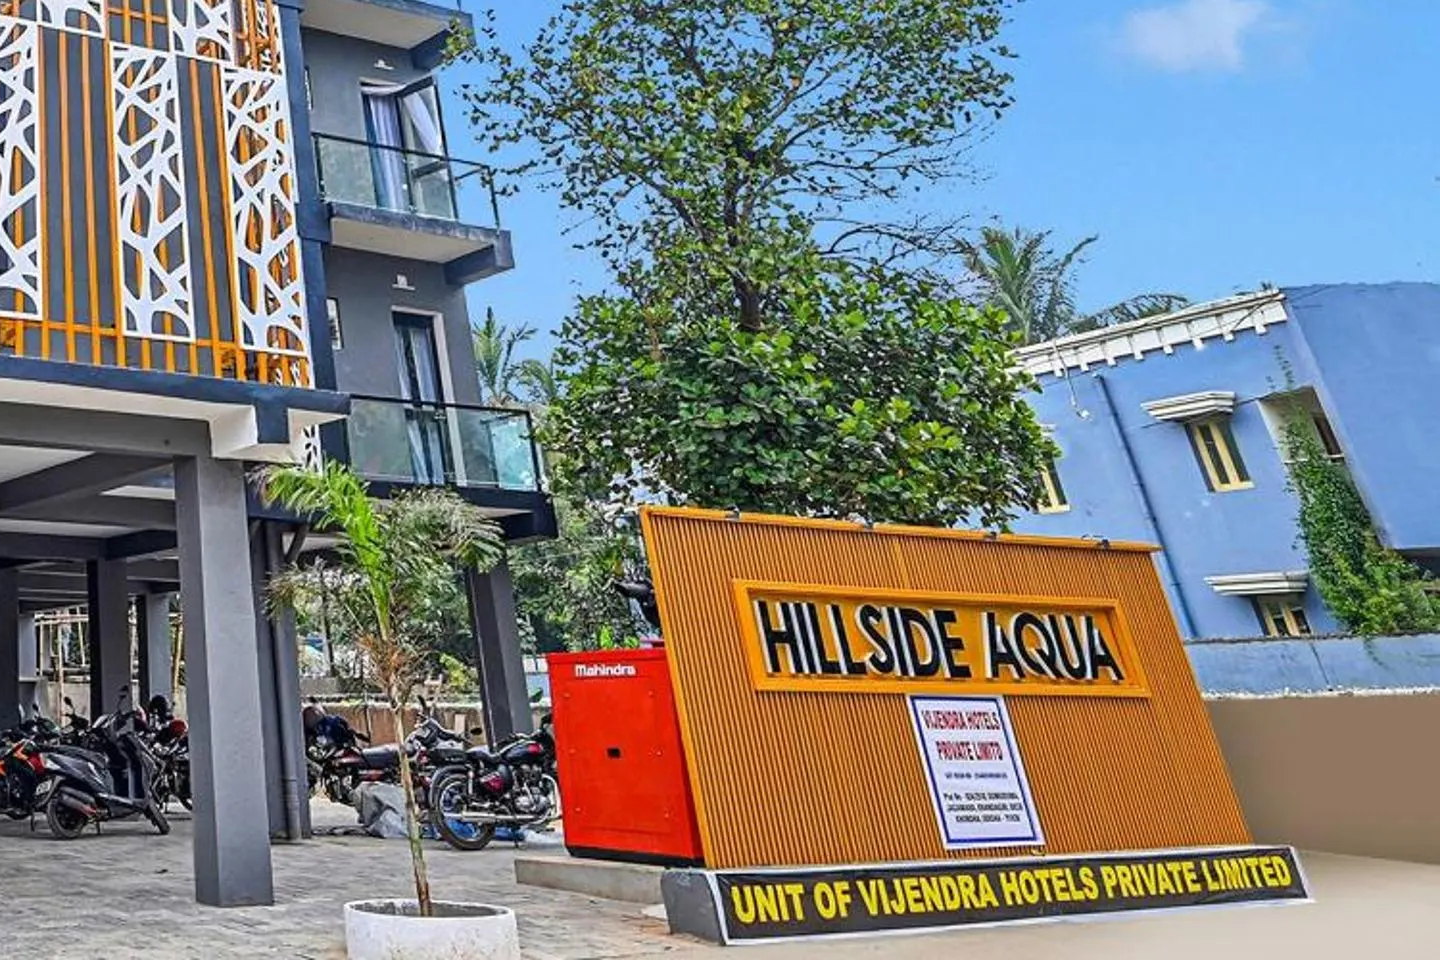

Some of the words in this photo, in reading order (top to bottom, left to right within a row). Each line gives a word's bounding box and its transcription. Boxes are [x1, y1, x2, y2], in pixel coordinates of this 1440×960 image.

[755, 599, 972, 679] HILLSIDE
[982, 611, 1124, 682] AQUA
[575, 663, 637, 677] Mahindra
[921, 710, 966, 730] VIJENDRA
[965, 710, 1001, 731] HOTELS
[935, 741, 975, 761] PRIVATE
[731, 882, 804, 924] UNIT
[813, 880, 852, 920] OF
[856, 872, 1000, 916] VIJENDRA
[998, 864, 1099, 906] HOTELS
[1100, 860, 1201, 898] PRIVATE
[1202, 855, 1292, 890] LIMITED
